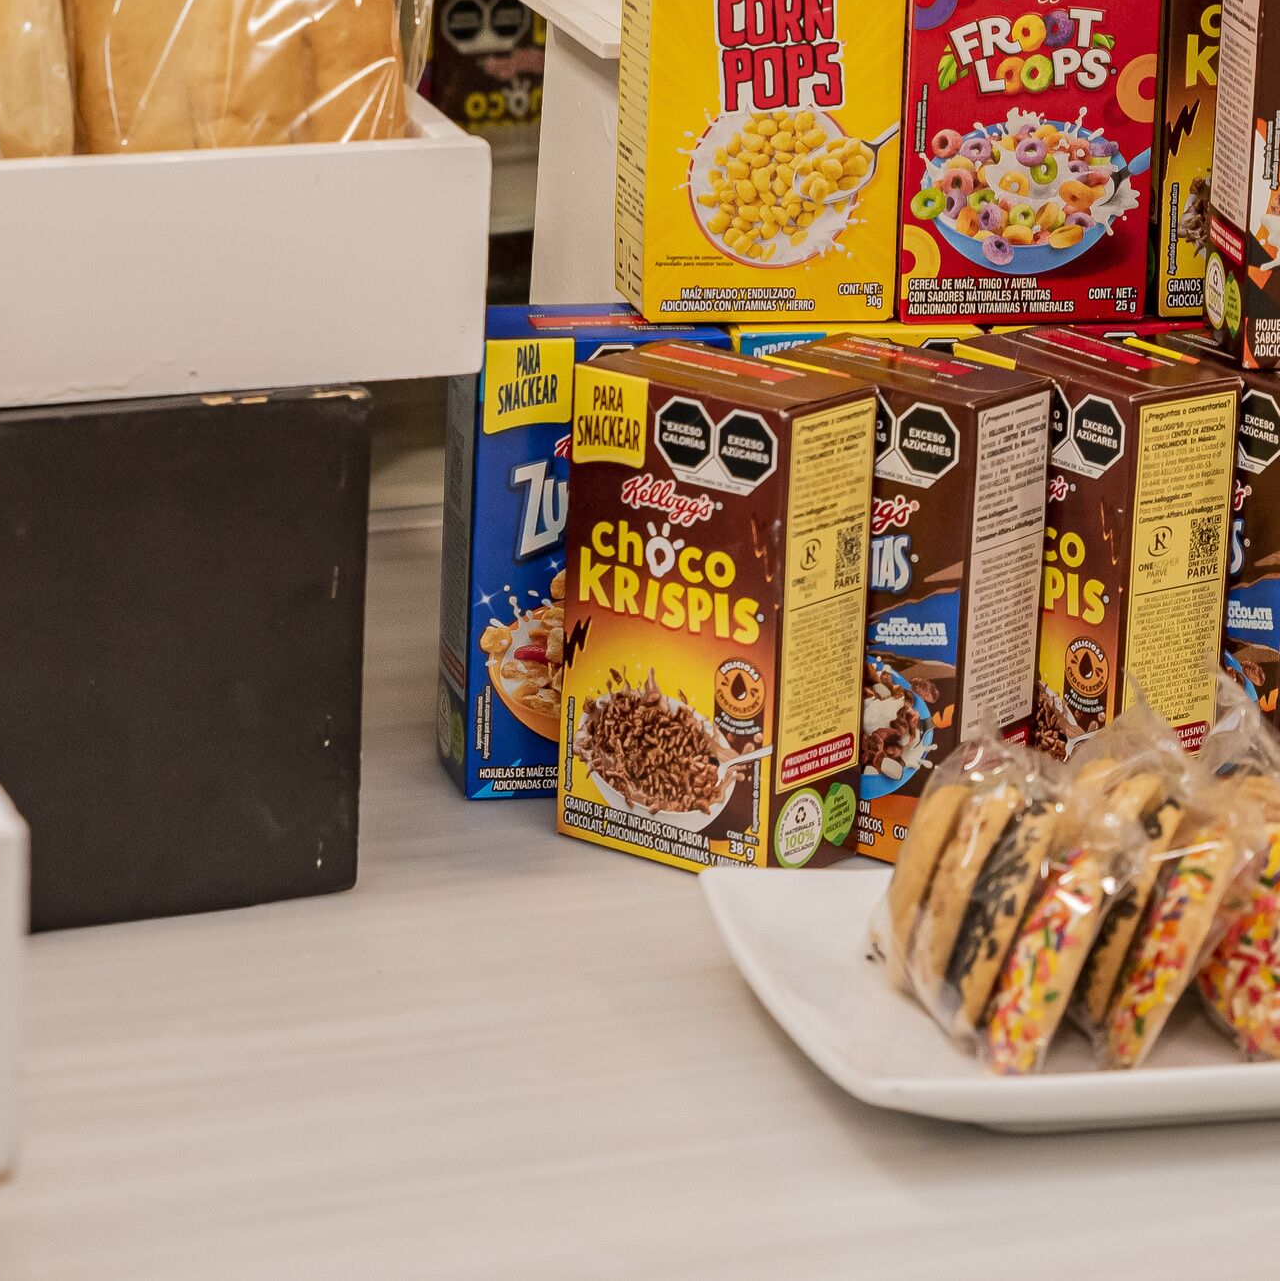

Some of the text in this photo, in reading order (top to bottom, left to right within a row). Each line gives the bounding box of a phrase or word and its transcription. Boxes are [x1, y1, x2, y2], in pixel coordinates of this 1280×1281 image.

[950, 6, 1104, 68] FROOT
[721, 42, 844, 112] POPS
[973, 46, 1113, 96] LOOPS
[515, 345, 541, 378] PARA
[497, 376, 558, 416] SNACKEAR
[593, 385, 623, 413] PARA
[577, 415, 640, 451] SNACKEAR
[1075, 430, 1119, 449] AZÚCARES
[1082, 417, 1114, 434] EXCESO
[621, 473, 713, 527] Kellogg's
[578, 546, 760, 645] KRISPIS
[782, 748, 853, 780] PARA VENTA EN MÉXICO
[785, 737, 851, 767] PRODUCTO EXCLUSIVO
[785, 830, 815, 850] 100%
